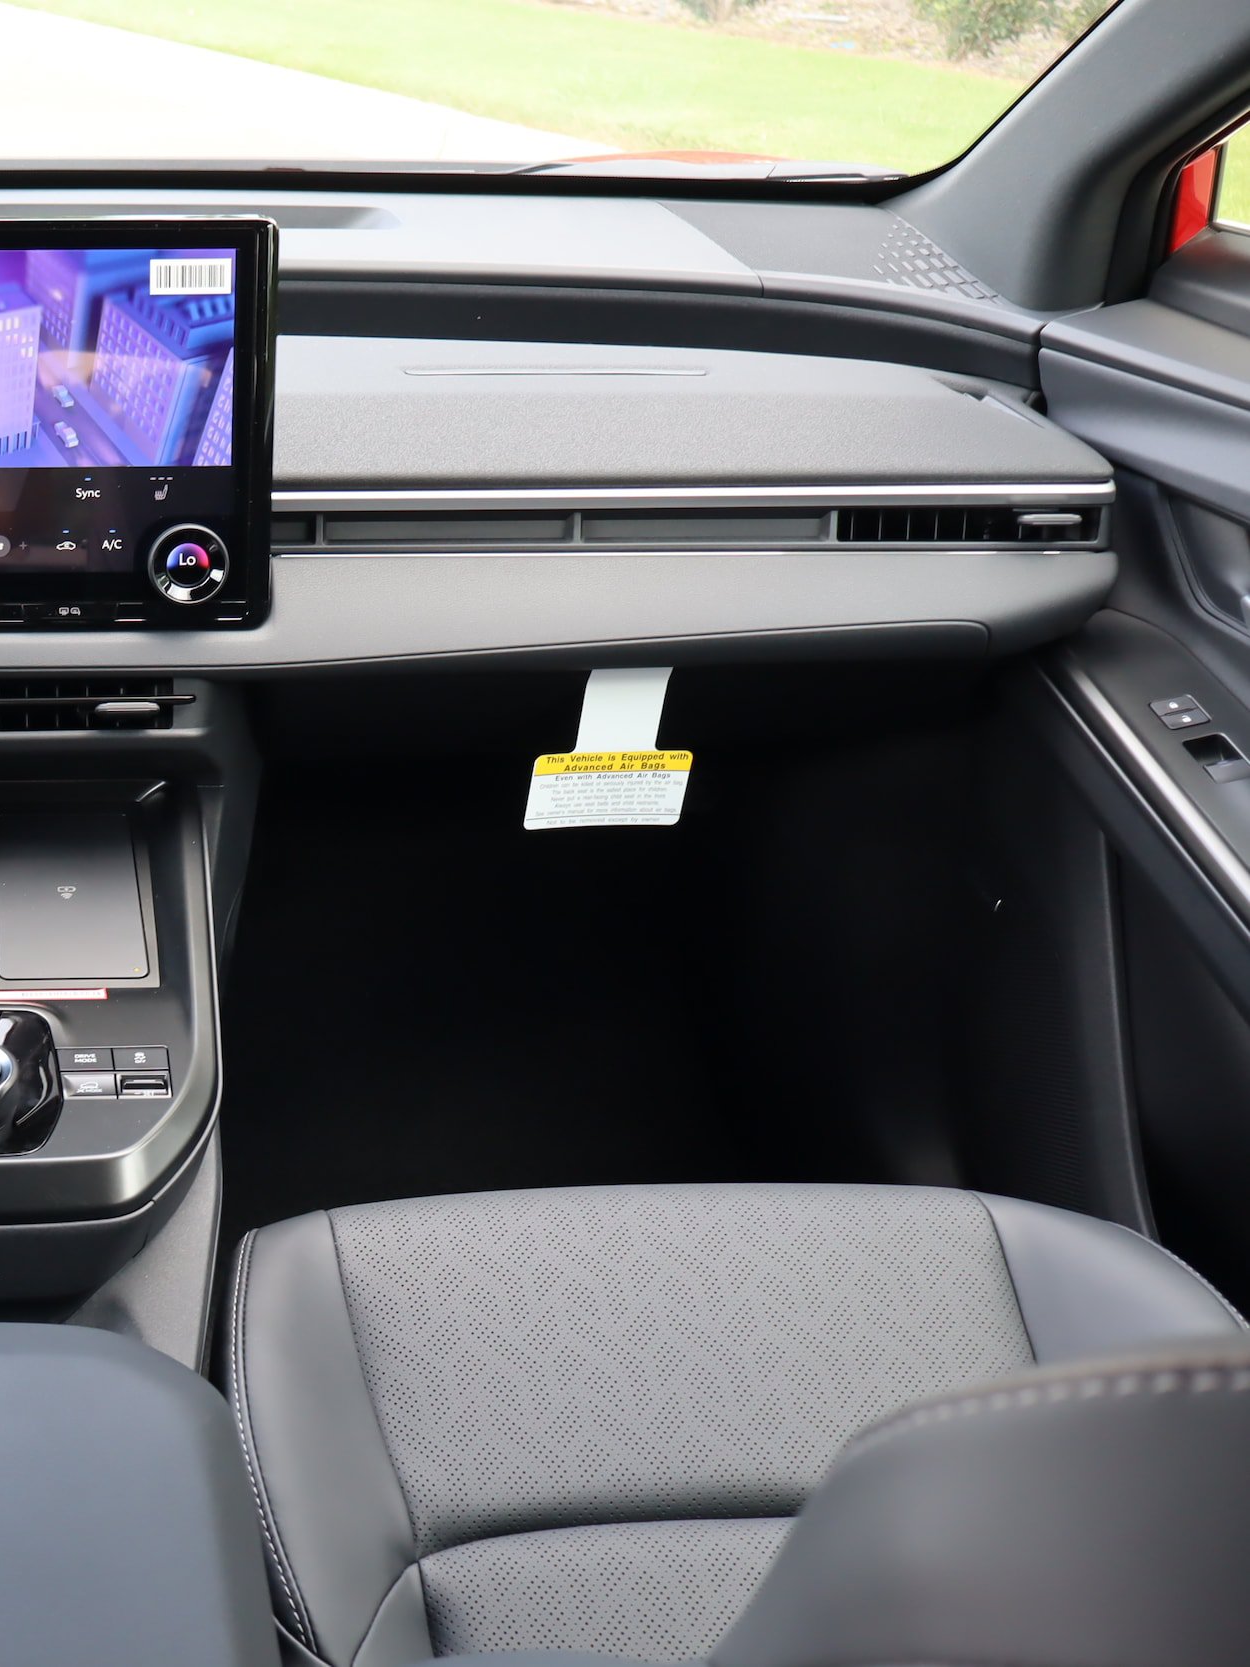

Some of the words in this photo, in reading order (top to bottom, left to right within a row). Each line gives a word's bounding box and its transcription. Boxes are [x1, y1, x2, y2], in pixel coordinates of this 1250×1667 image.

[75, 487, 100, 500] Sync
[102, 539, 123, 551] A/C
[179, 553, 196, 566] Lo
[546, 756, 565, 764] This
[570, 755, 603, 763] Vehicle
[621, 753, 665, 762] Equipped
[564, 763, 613, 771] Advanced
[640, 762, 666, 770] Bags
